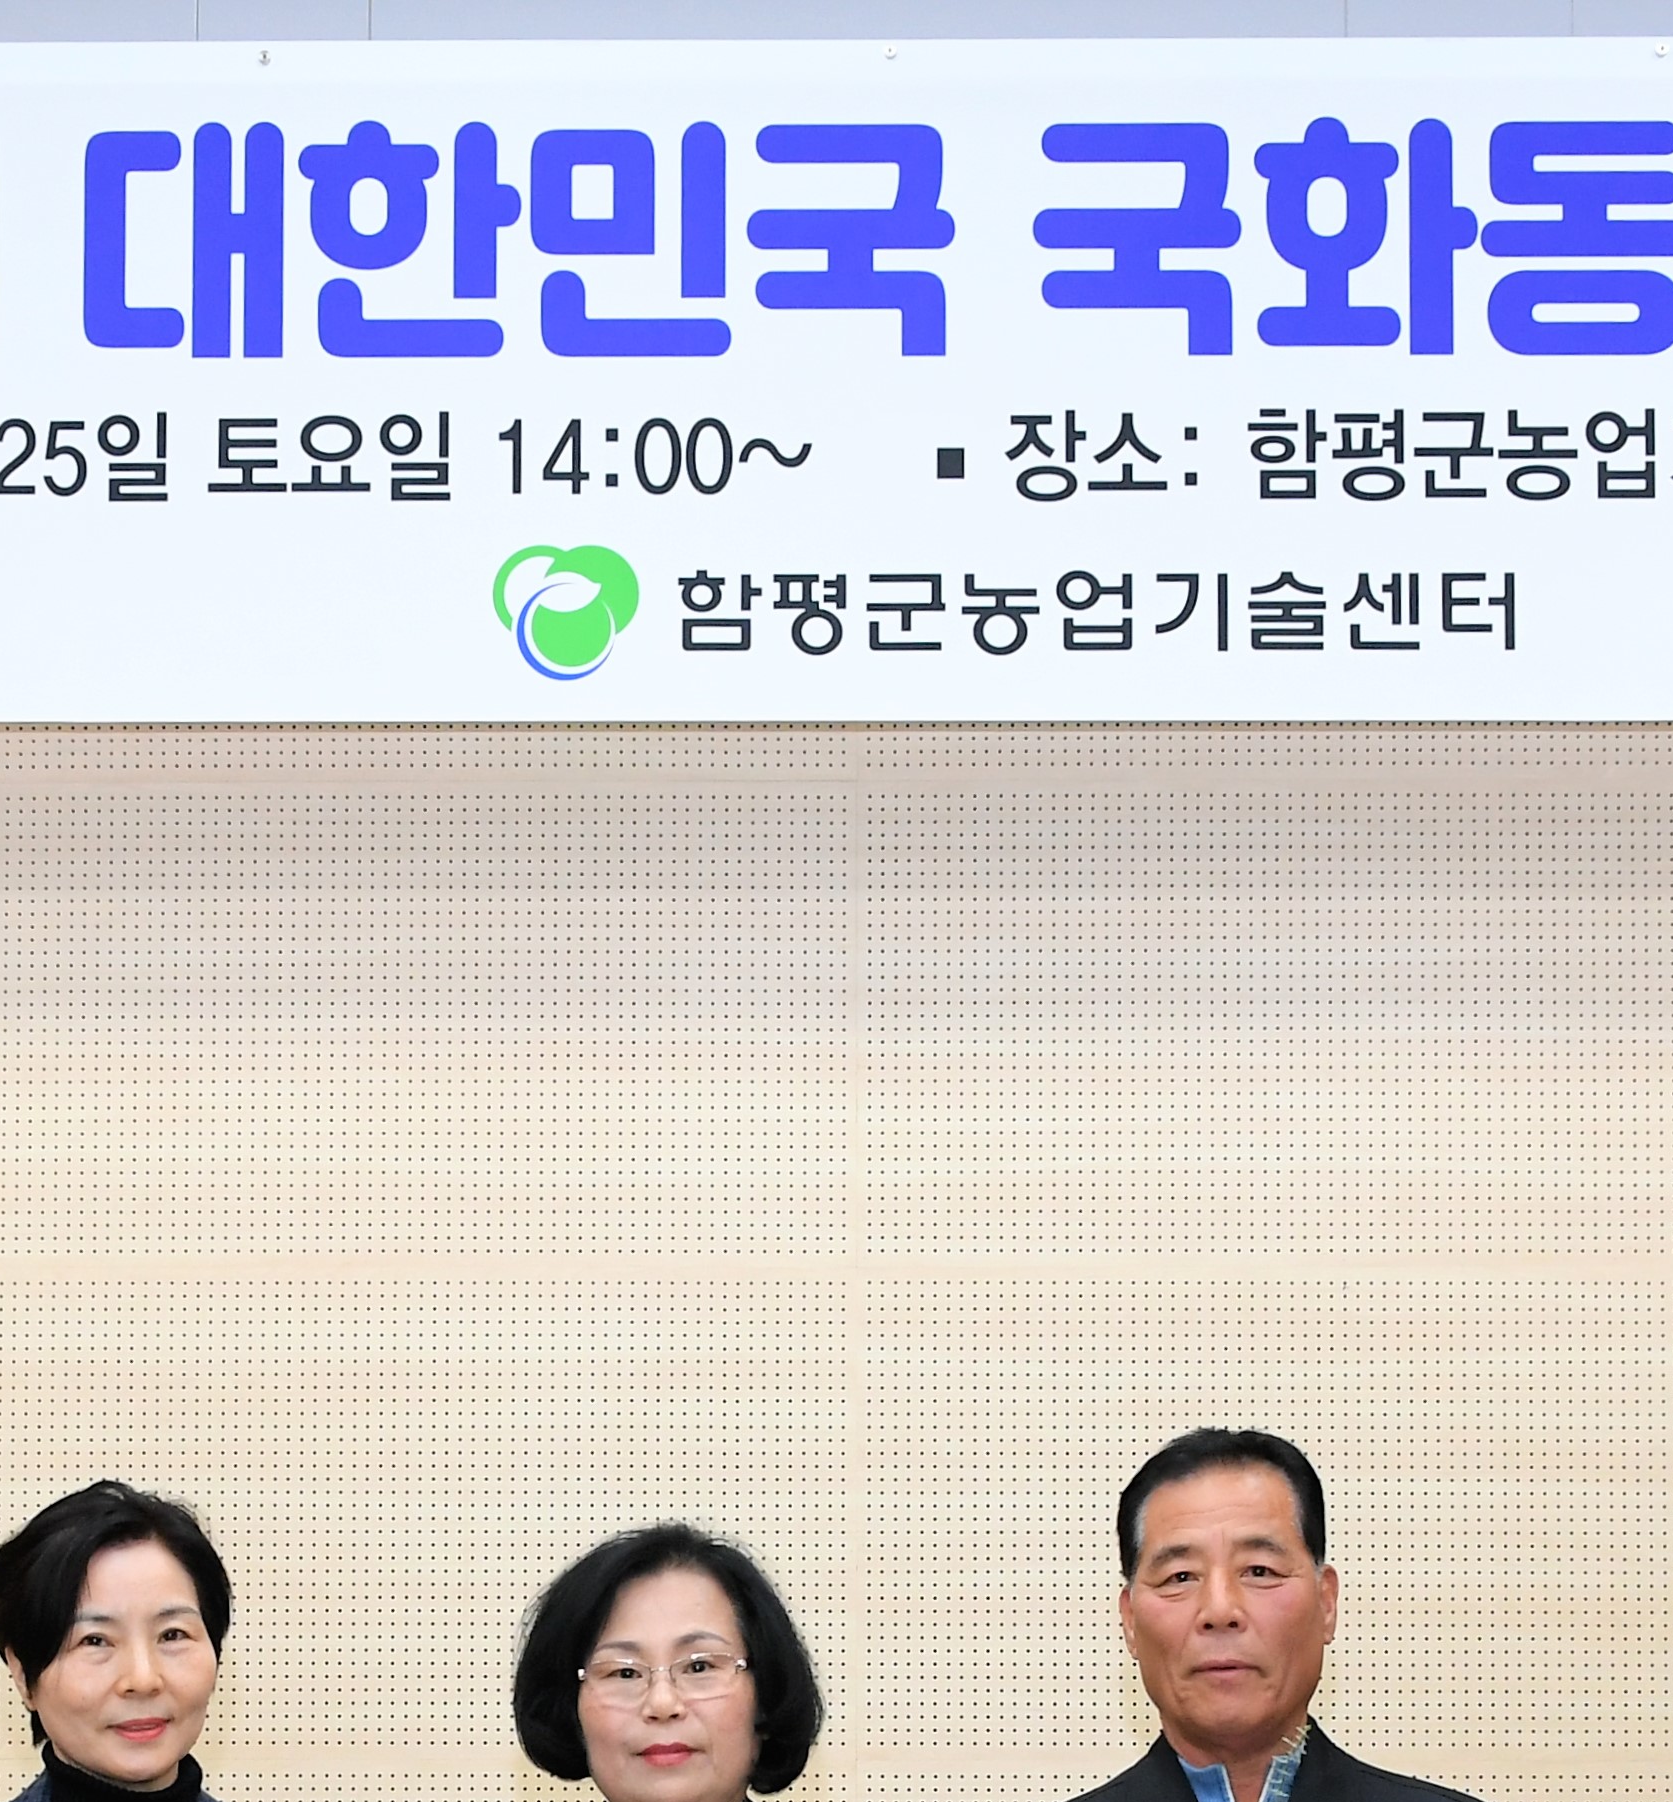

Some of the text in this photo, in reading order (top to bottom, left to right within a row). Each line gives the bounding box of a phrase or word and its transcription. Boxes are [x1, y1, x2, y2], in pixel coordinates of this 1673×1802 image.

[83, 120, 956, 359] 대한민국
[207, 410, 451, 501] 토요일
[1004, 409, 1198, 502] 장소:
[677, 569, 1516, 656] 함평군농업기술센터
